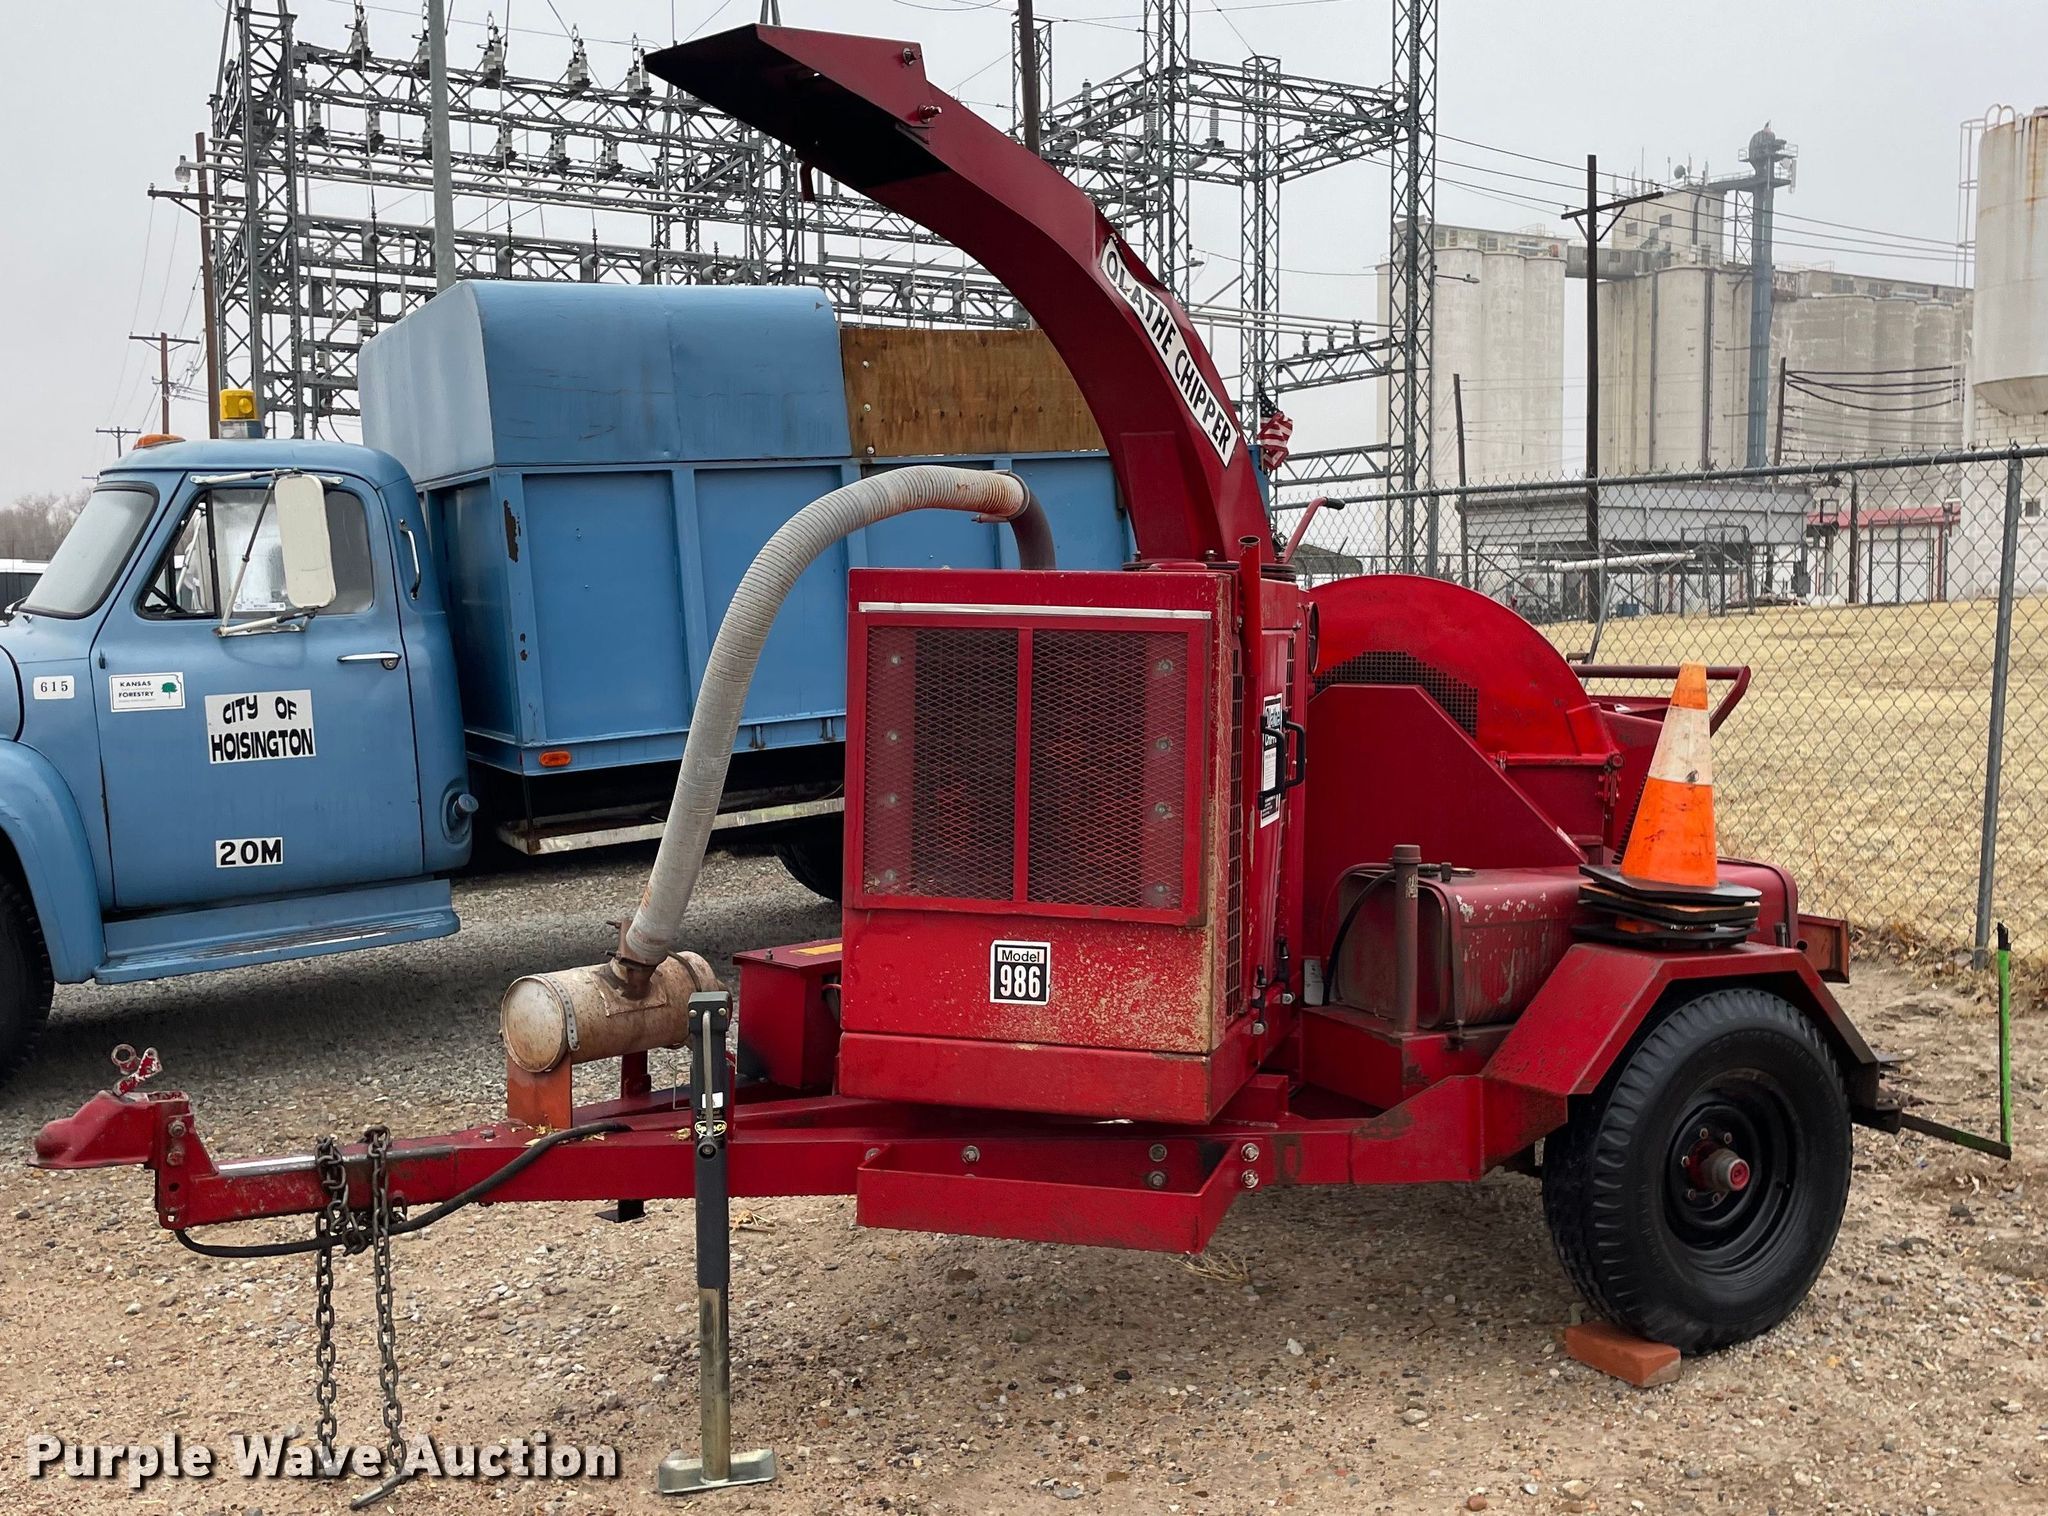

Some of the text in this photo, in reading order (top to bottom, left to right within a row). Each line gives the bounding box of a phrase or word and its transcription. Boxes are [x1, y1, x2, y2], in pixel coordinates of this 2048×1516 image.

[1106, 250, 1232, 455] OLATHE CHIPPER
[40, 681, 68, 692] 615
[223, 695, 297, 724] CITY OF
[211, 728, 314, 762] HOISINGTON
[220, 839, 282, 865] 20M
[1002, 950, 1040, 962] Model
[1000, 964, 1040, 998] 986
